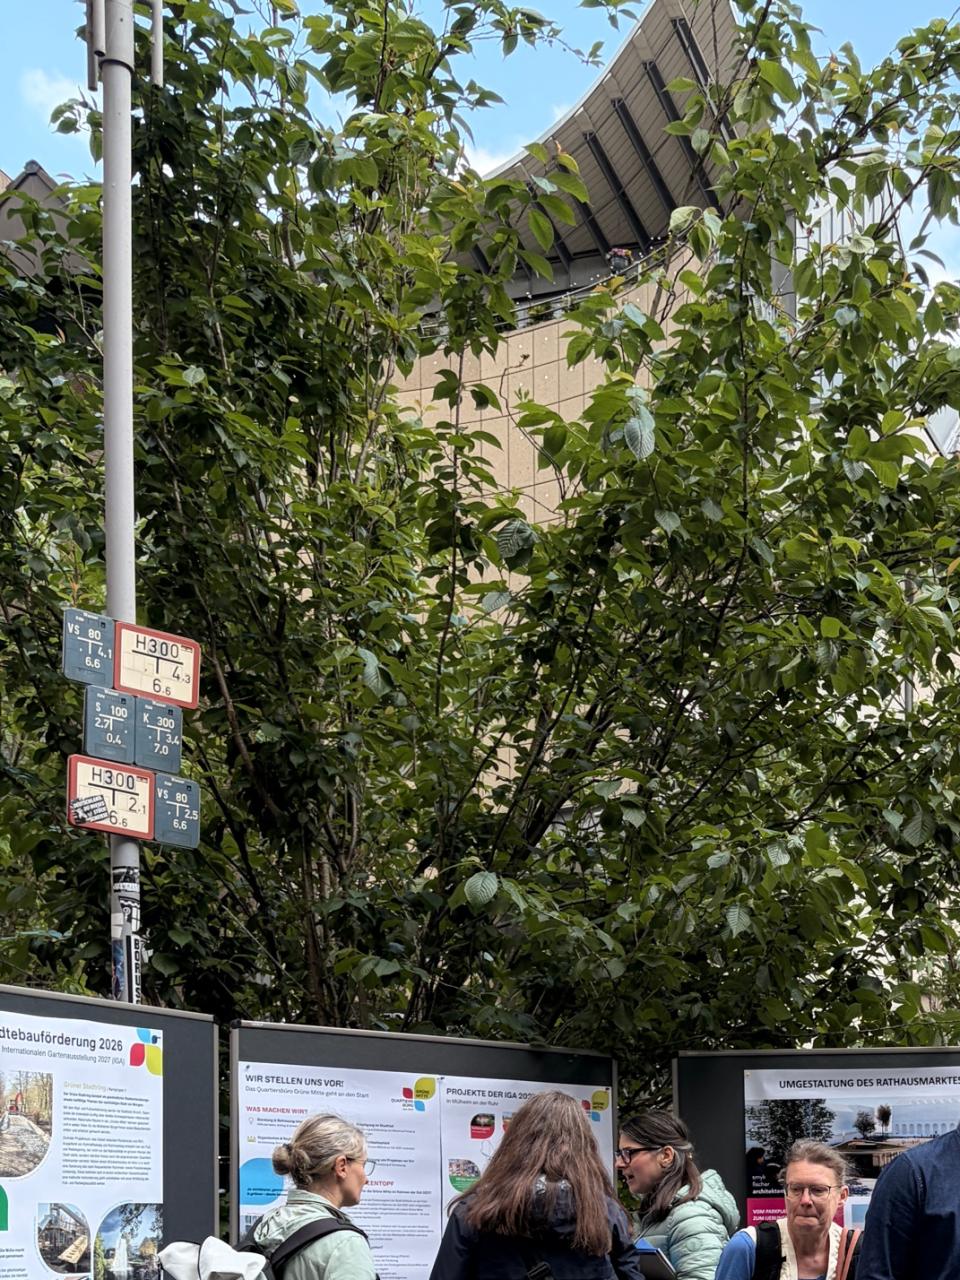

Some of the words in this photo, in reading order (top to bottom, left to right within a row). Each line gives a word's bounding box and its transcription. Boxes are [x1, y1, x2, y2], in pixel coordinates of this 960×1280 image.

[67, 622, 80, 636] VS
[88, 628, 102, 641] 80
[85, 656, 101, 669] 6.6
[172, 665, 191, 684] 4.3
[152, 678, 172, 696] 6.6
[95, 702, 101, 712] S
[111, 705, 128, 718] 100
[143, 713, 149, 723] K
[157, 716, 175, 729] 300
[106, 732, 122, 744] 0.4
[157, 788, 168, 799] VS
[175, 792, 188, 803] 80
[109, 811, 128, 827] 6.6
[98, 1037, 123, 1052] 2026
[245, 1074, 263, 1082] WIR
[264, 1075, 303, 1085] STELLEN
[304, 1078, 322, 1087] UNS
[779, 1078, 854, 1089] UMGESTALTUNG
[856, 1078, 874, 1087] DES
[446, 1088, 486, 1097] PROJEKTE
[488, 1090, 504, 1098] DER
[504, 1091, 517, 1099] IGA
